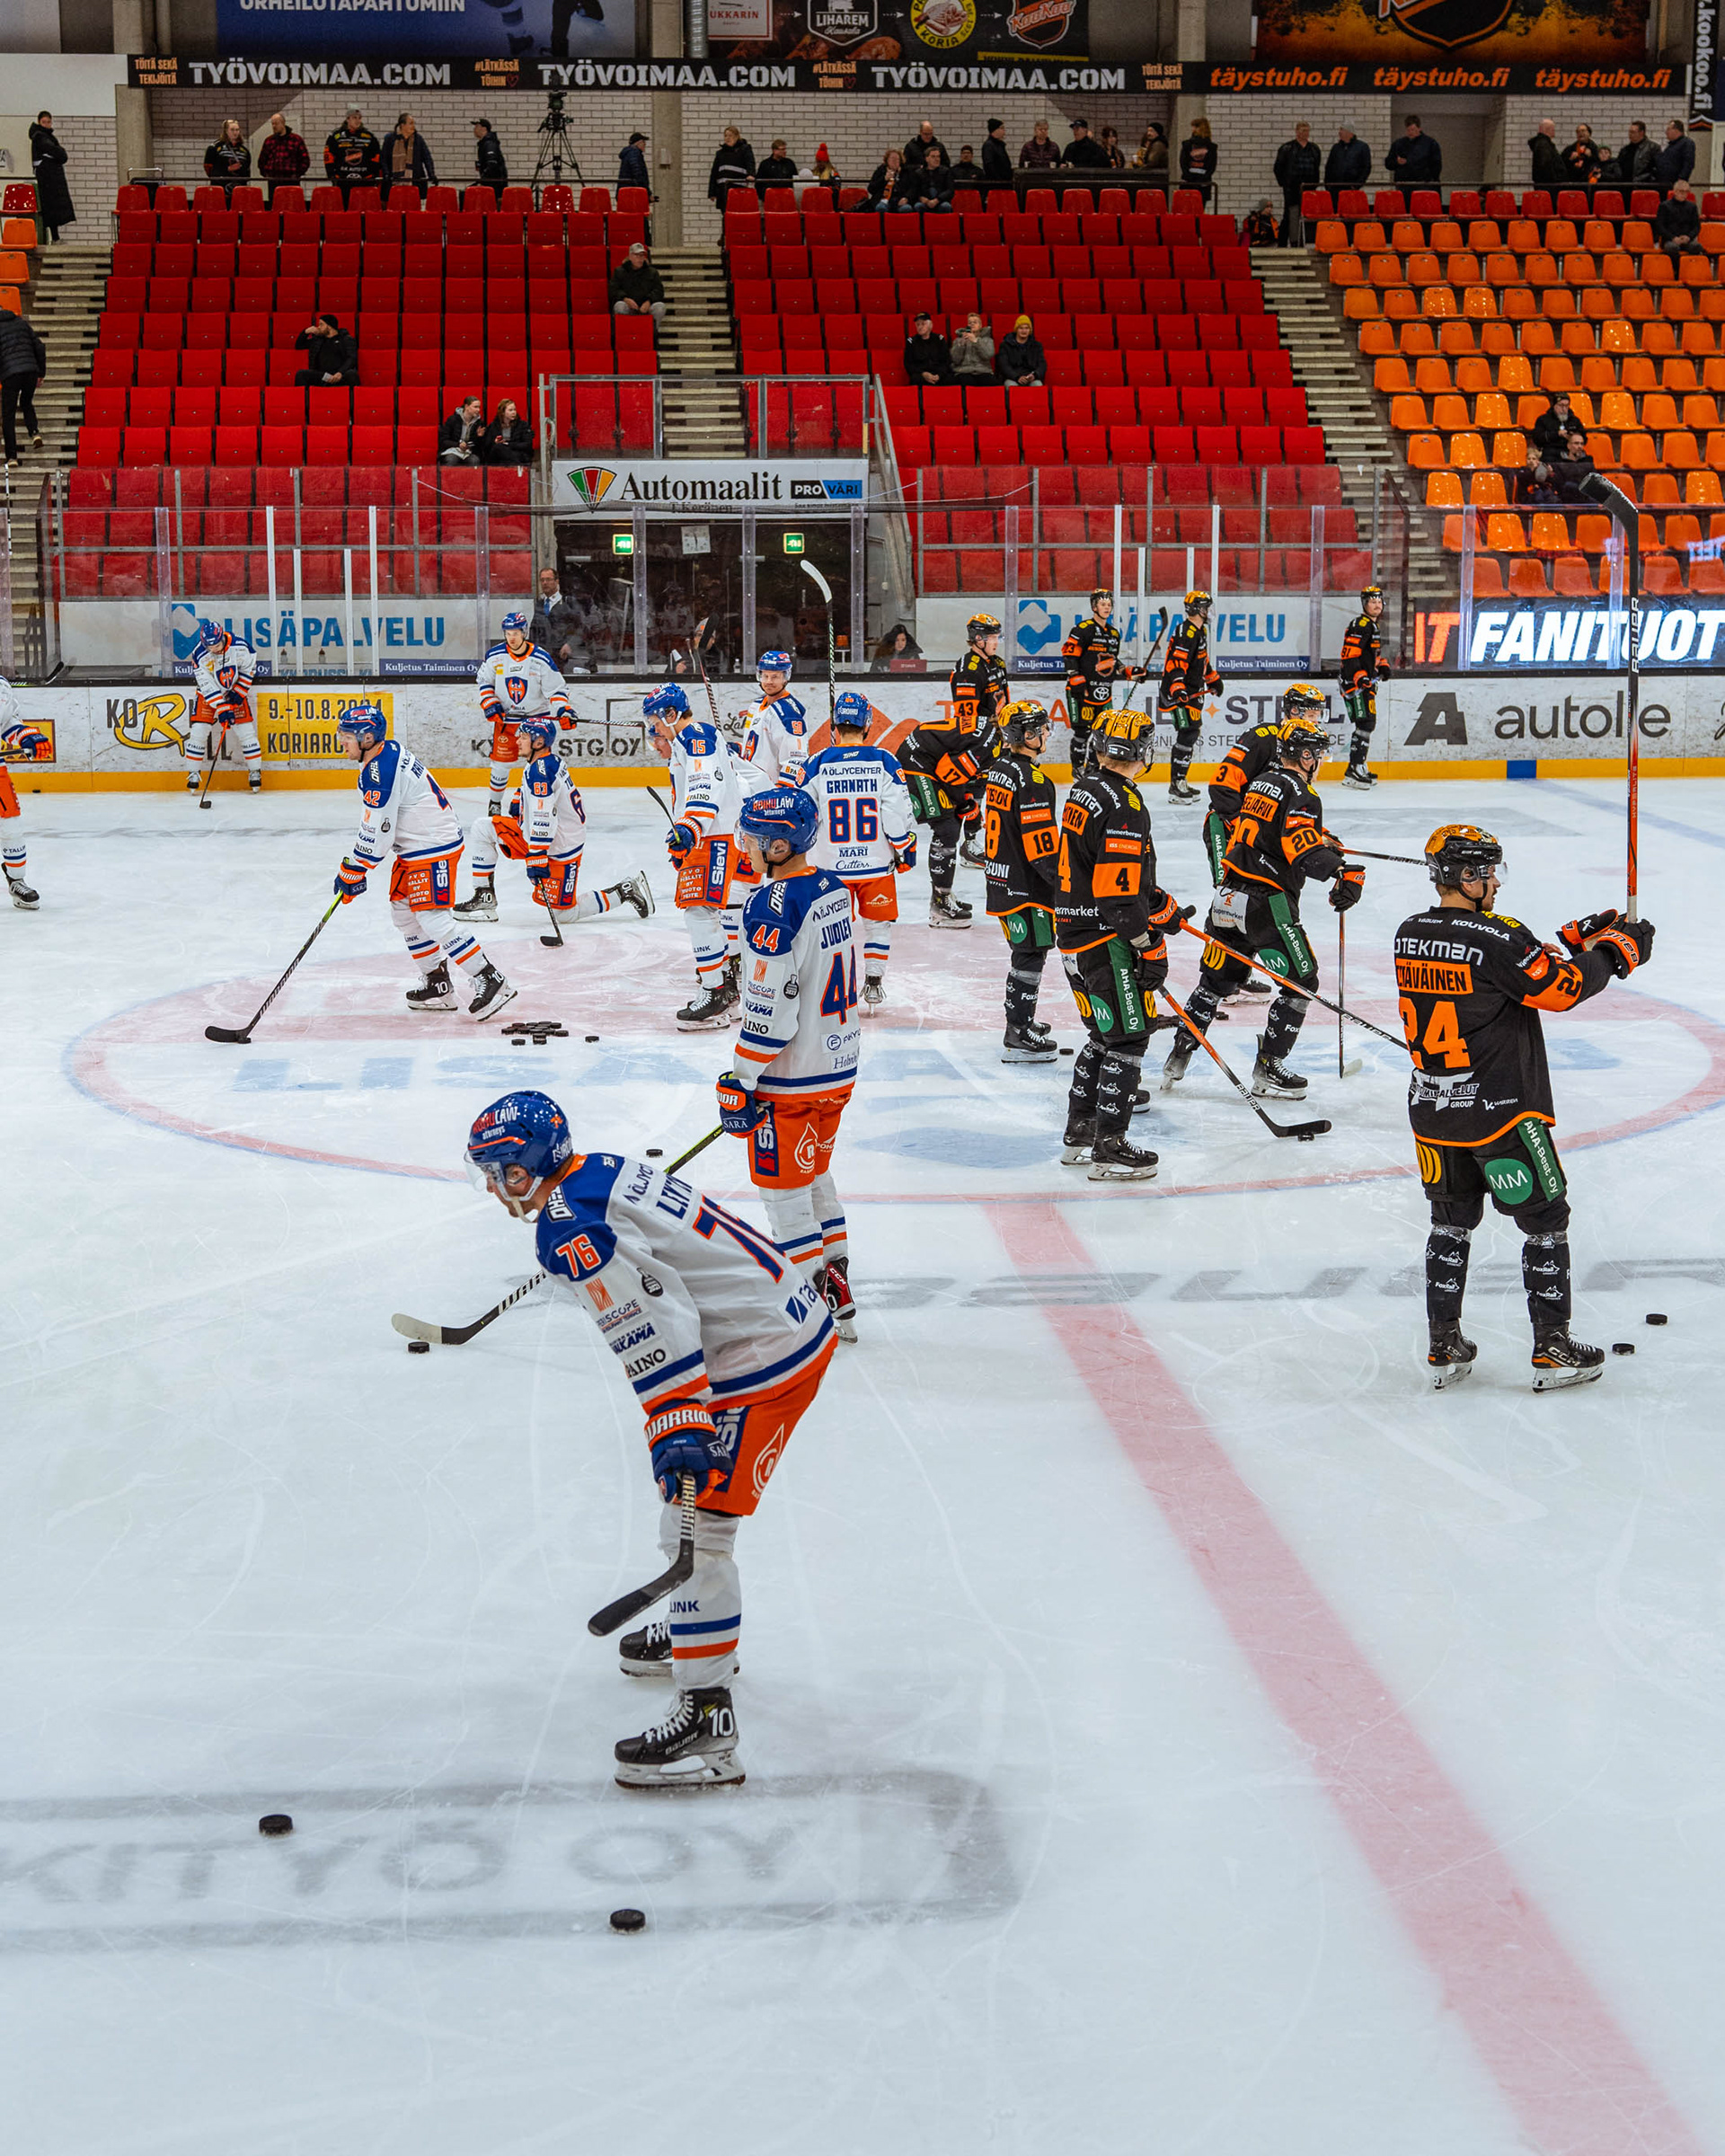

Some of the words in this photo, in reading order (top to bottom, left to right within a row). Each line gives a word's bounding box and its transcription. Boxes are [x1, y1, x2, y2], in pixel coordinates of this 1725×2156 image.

[816, 14, 869, 27] LIHAREM
[922, 28, 960, 48] KORIA
[158, 57, 178, 70] SEKÄ
[189, 57, 450, 85] TYÖVOIMAA.COM
[538, 59, 795, 87] TYÖVOIMAA.COM
[871, 62, 1125, 90] TYÖVOIMAA.COM
[1210, 66, 1348, 91] täystuho.fi
[1374, 66, 1510, 91] täystuho.fi
[1535, 68, 1671, 92] täystuho.fi
[620, 471, 783, 500] Automaalit
[795, 486, 821, 495] PRO
[827, 482, 859, 495] VÄRI
[1415, 612, 1460, 663] IT
[385, 662, 421, 674] Kuljetus
[424, 663, 465, 673] Taiminen
[1017, 659, 1053, 672] Kuljetus
[1218, 659, 1253, 672] Kuljetus
[1256, 659, 1296, 669] Taiminen
[1298, 660, 1309, 672] Oy
[958, 702, 974, 717] 43
[1494, 691, 1670, 738] autole
[691, 738, 706, 755] 15
[827, 765, 881, 776] ÖLJYCENTER
[942, 768, 962, 782] 17
[1216, 764, 1228, 782] 3
[534, 782, 548, 796] 63
[826, 778, 878, 794] GRANATH
[1100, 780, 1121, 809] KOUVOLA
[364, 790, 381, 806] 42
[828, 797, 880, 844] 86
[1032, 831, 1054, 854] 18
[1106, 827, 1143, 839] Wienerberger
[1291, 828, 1319, 852] 20
[711, 842, 727, 886] Sievi
[839, 847, 869, 858] MARI
[1057, 833, 1072, 893] 4
[437, 860, 448, 888] Sie
[1115, 867, 1130, 892] 4
[1054, 904, 1100, 919] ermarket
[753, 923, 780, 952] 44
[1451, 918, 1511, 942] KOUVOLA
[1281, 922, 1305, 963] AHA-Best
[435, 981, 448, 994] 10
[491, 970, 505, 984] 10
[1119, 968, 1137, 1015] AHA-Best
[1398, 996, 1471, 1069] 24
[1450, 1100, 1474, 1109] GROUP
[722, 1118, 748, 1129] SARA
[1523, 1119, 1552, 1176] AHA-Best
[1548, 1178, 1559, 1194] Oy
[1489, 1169, 1528, 1190] MM
[555, 1233, 603, 1279] 76
[829, 1268, 846, 1285] CCM
[708, 1708, 735, 1738] 10
[665, 1730, 700, 1756] BAUER
